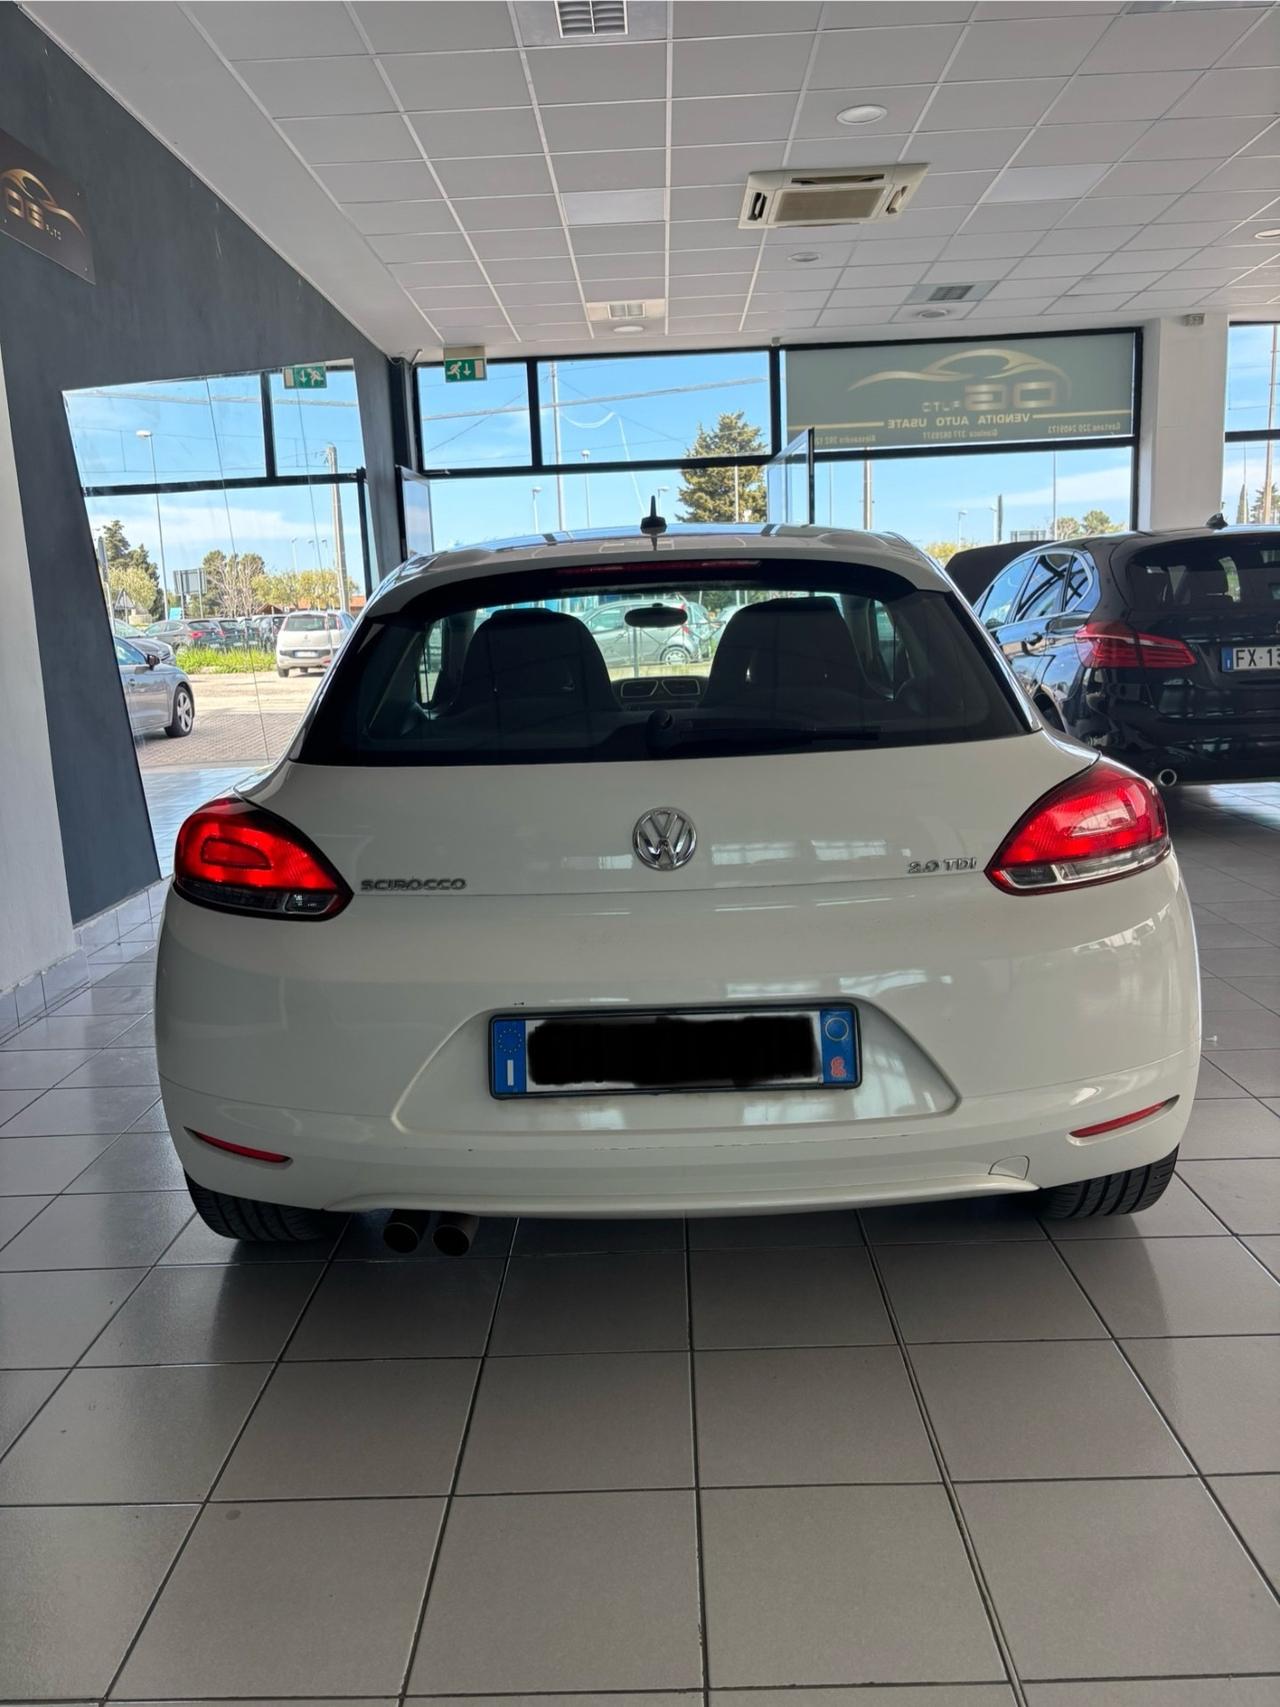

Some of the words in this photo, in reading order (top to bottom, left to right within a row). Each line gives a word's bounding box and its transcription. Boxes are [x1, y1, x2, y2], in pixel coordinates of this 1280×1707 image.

[907, 859, 940, 874] 2.0
[943, 857, 977, 872] TDI
[360, 879, 467, 892] SCIROCCO
